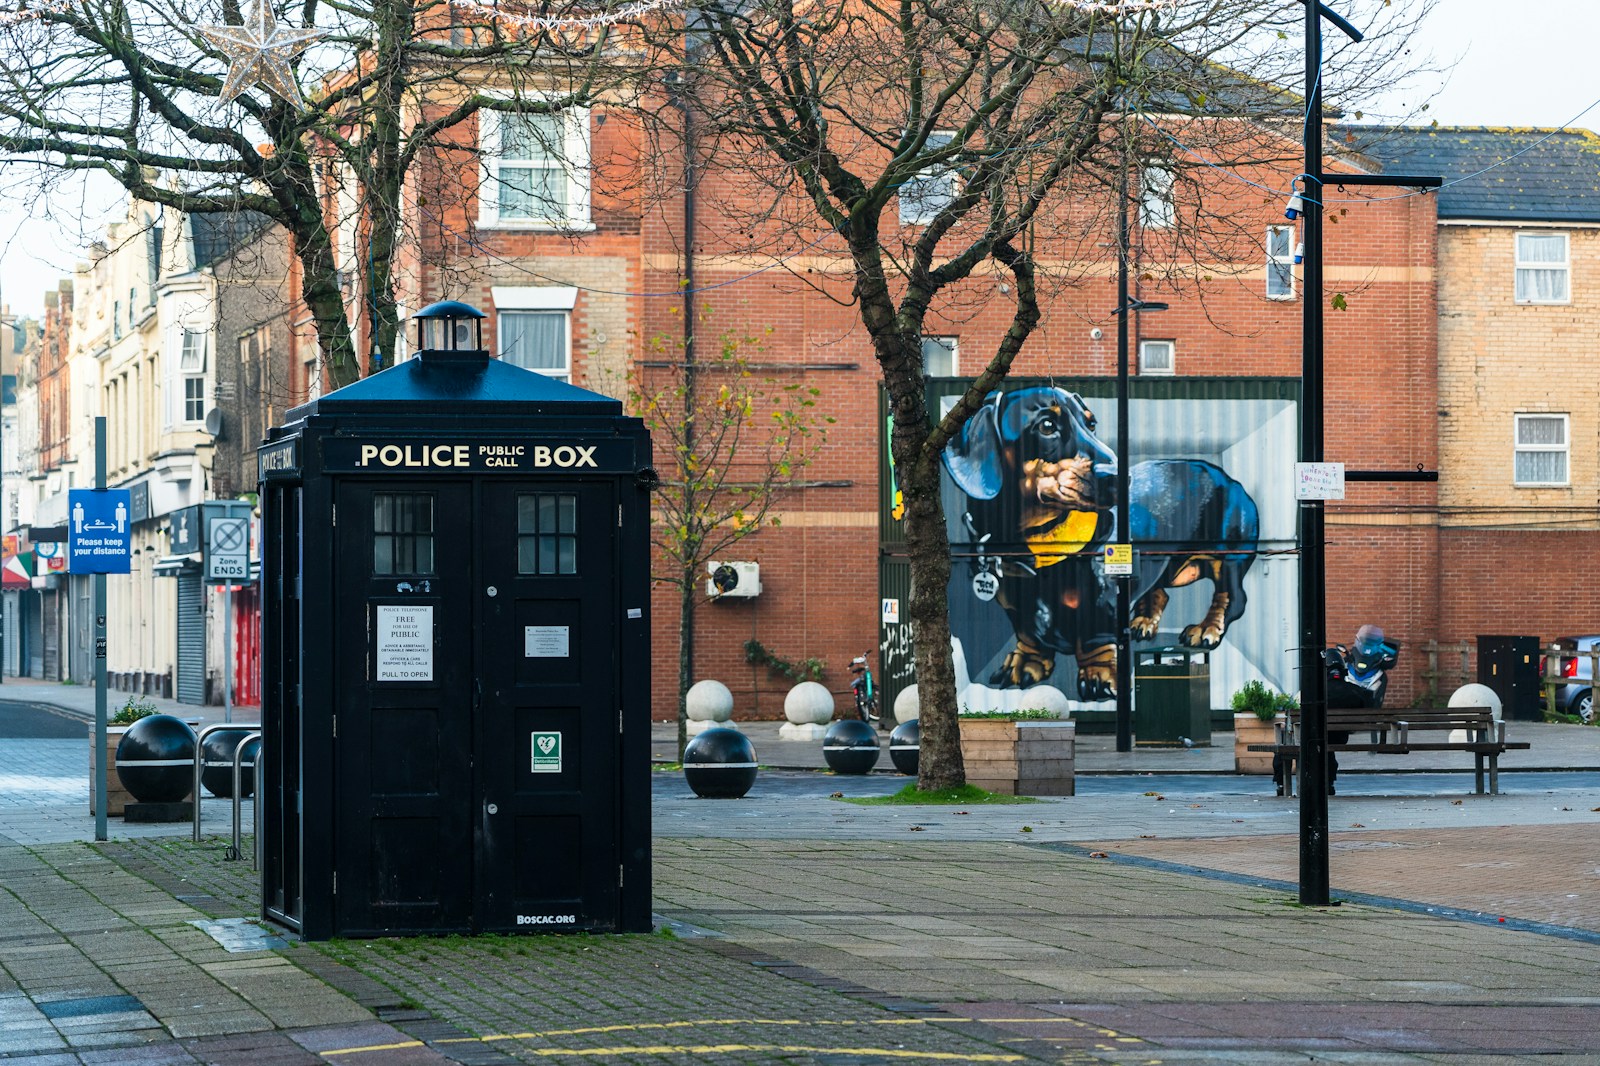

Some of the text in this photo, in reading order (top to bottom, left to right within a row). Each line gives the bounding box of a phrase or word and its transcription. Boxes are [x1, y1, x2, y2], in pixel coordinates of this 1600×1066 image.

[361, 444, 598, 467] POLICE BOX
[479, 446, 525, 456] PUBLIC
[485, 457, 518, 467] CALL
[77, 538, 123, 548] Please keep
[74, 547, 126, 557] your distance
[214, 566, 243, 575] ENDS
